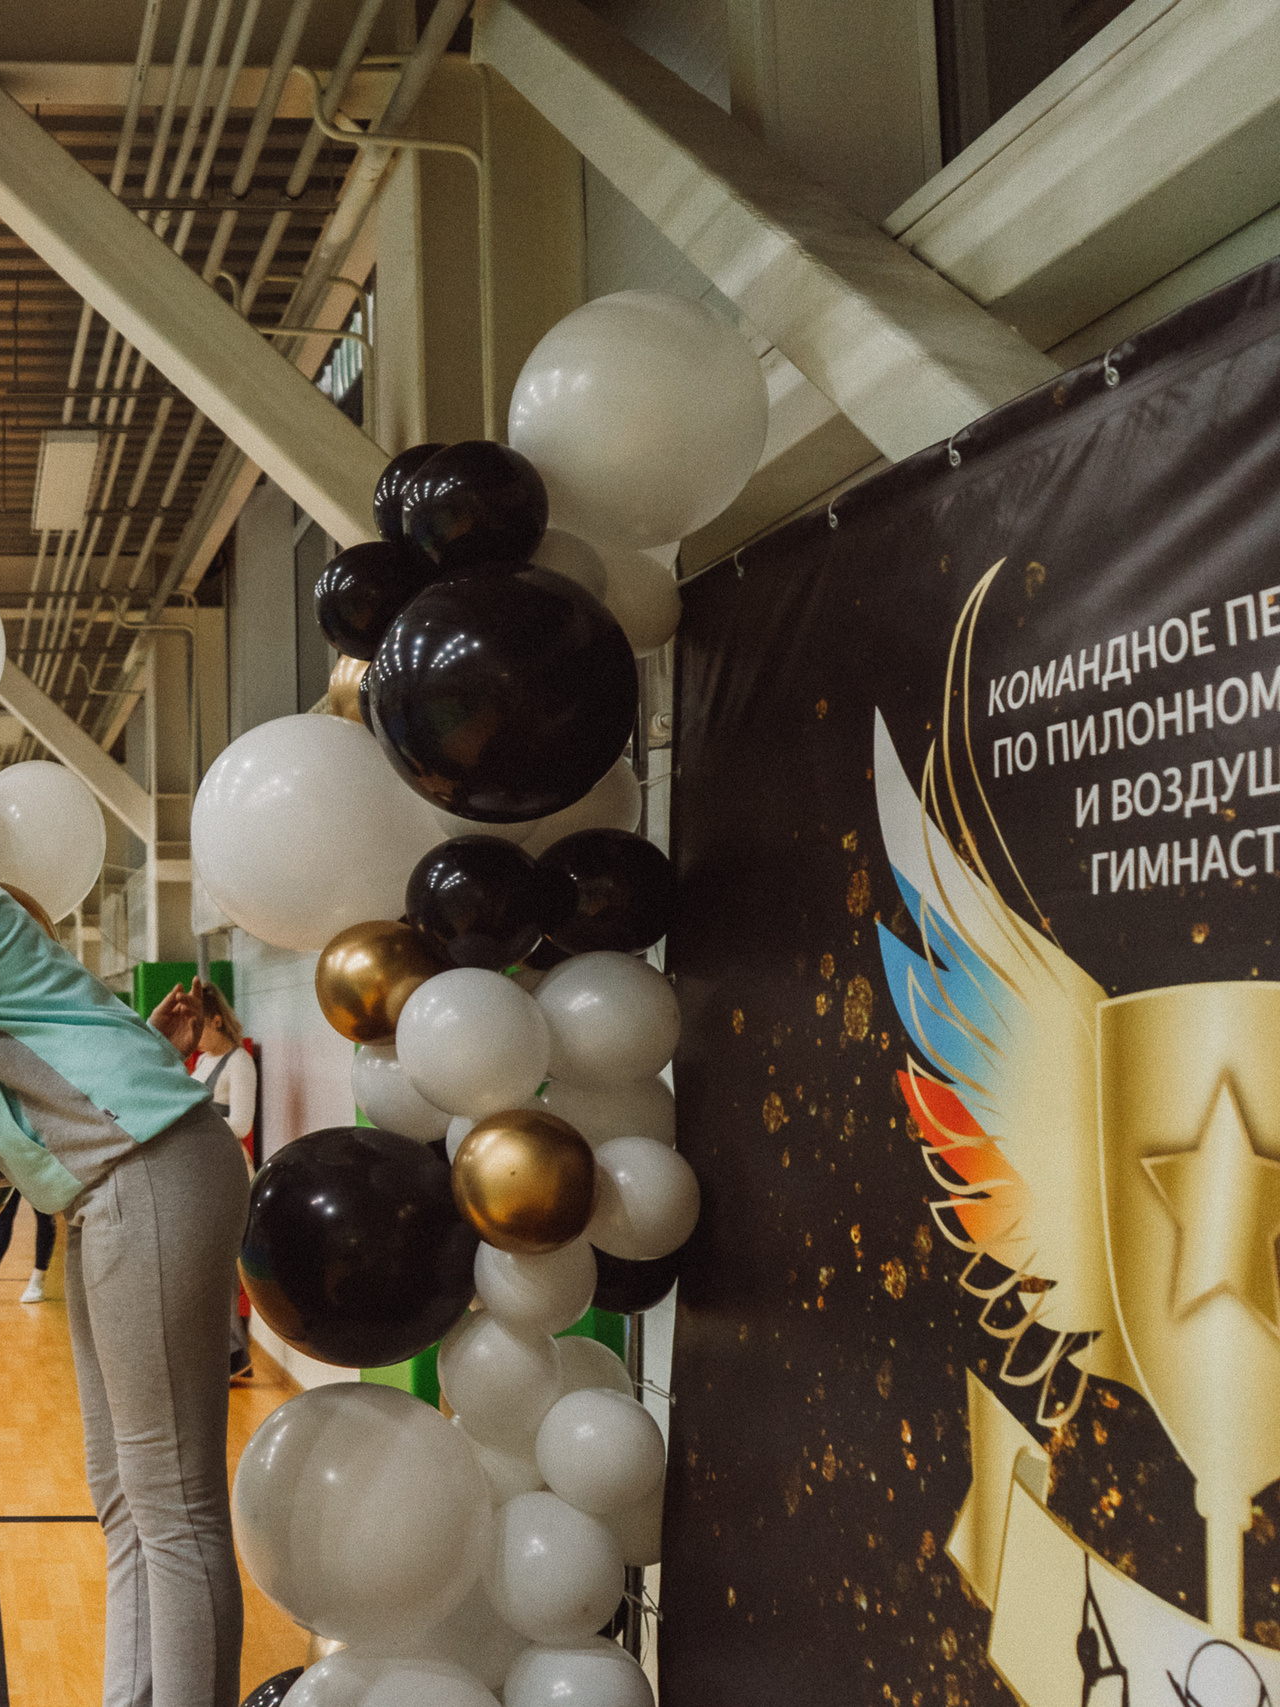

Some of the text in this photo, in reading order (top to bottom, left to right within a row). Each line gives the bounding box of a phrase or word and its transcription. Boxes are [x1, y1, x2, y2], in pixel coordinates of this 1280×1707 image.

[988, 607, 1216, 717] КОМАНДНОЕ
[993, 665, 1280, 779] ПО ПИЛОННОМ
[1076, 783, 1100, 829] И
[1091, 824, 1280, 896] ГИМНАСТ
